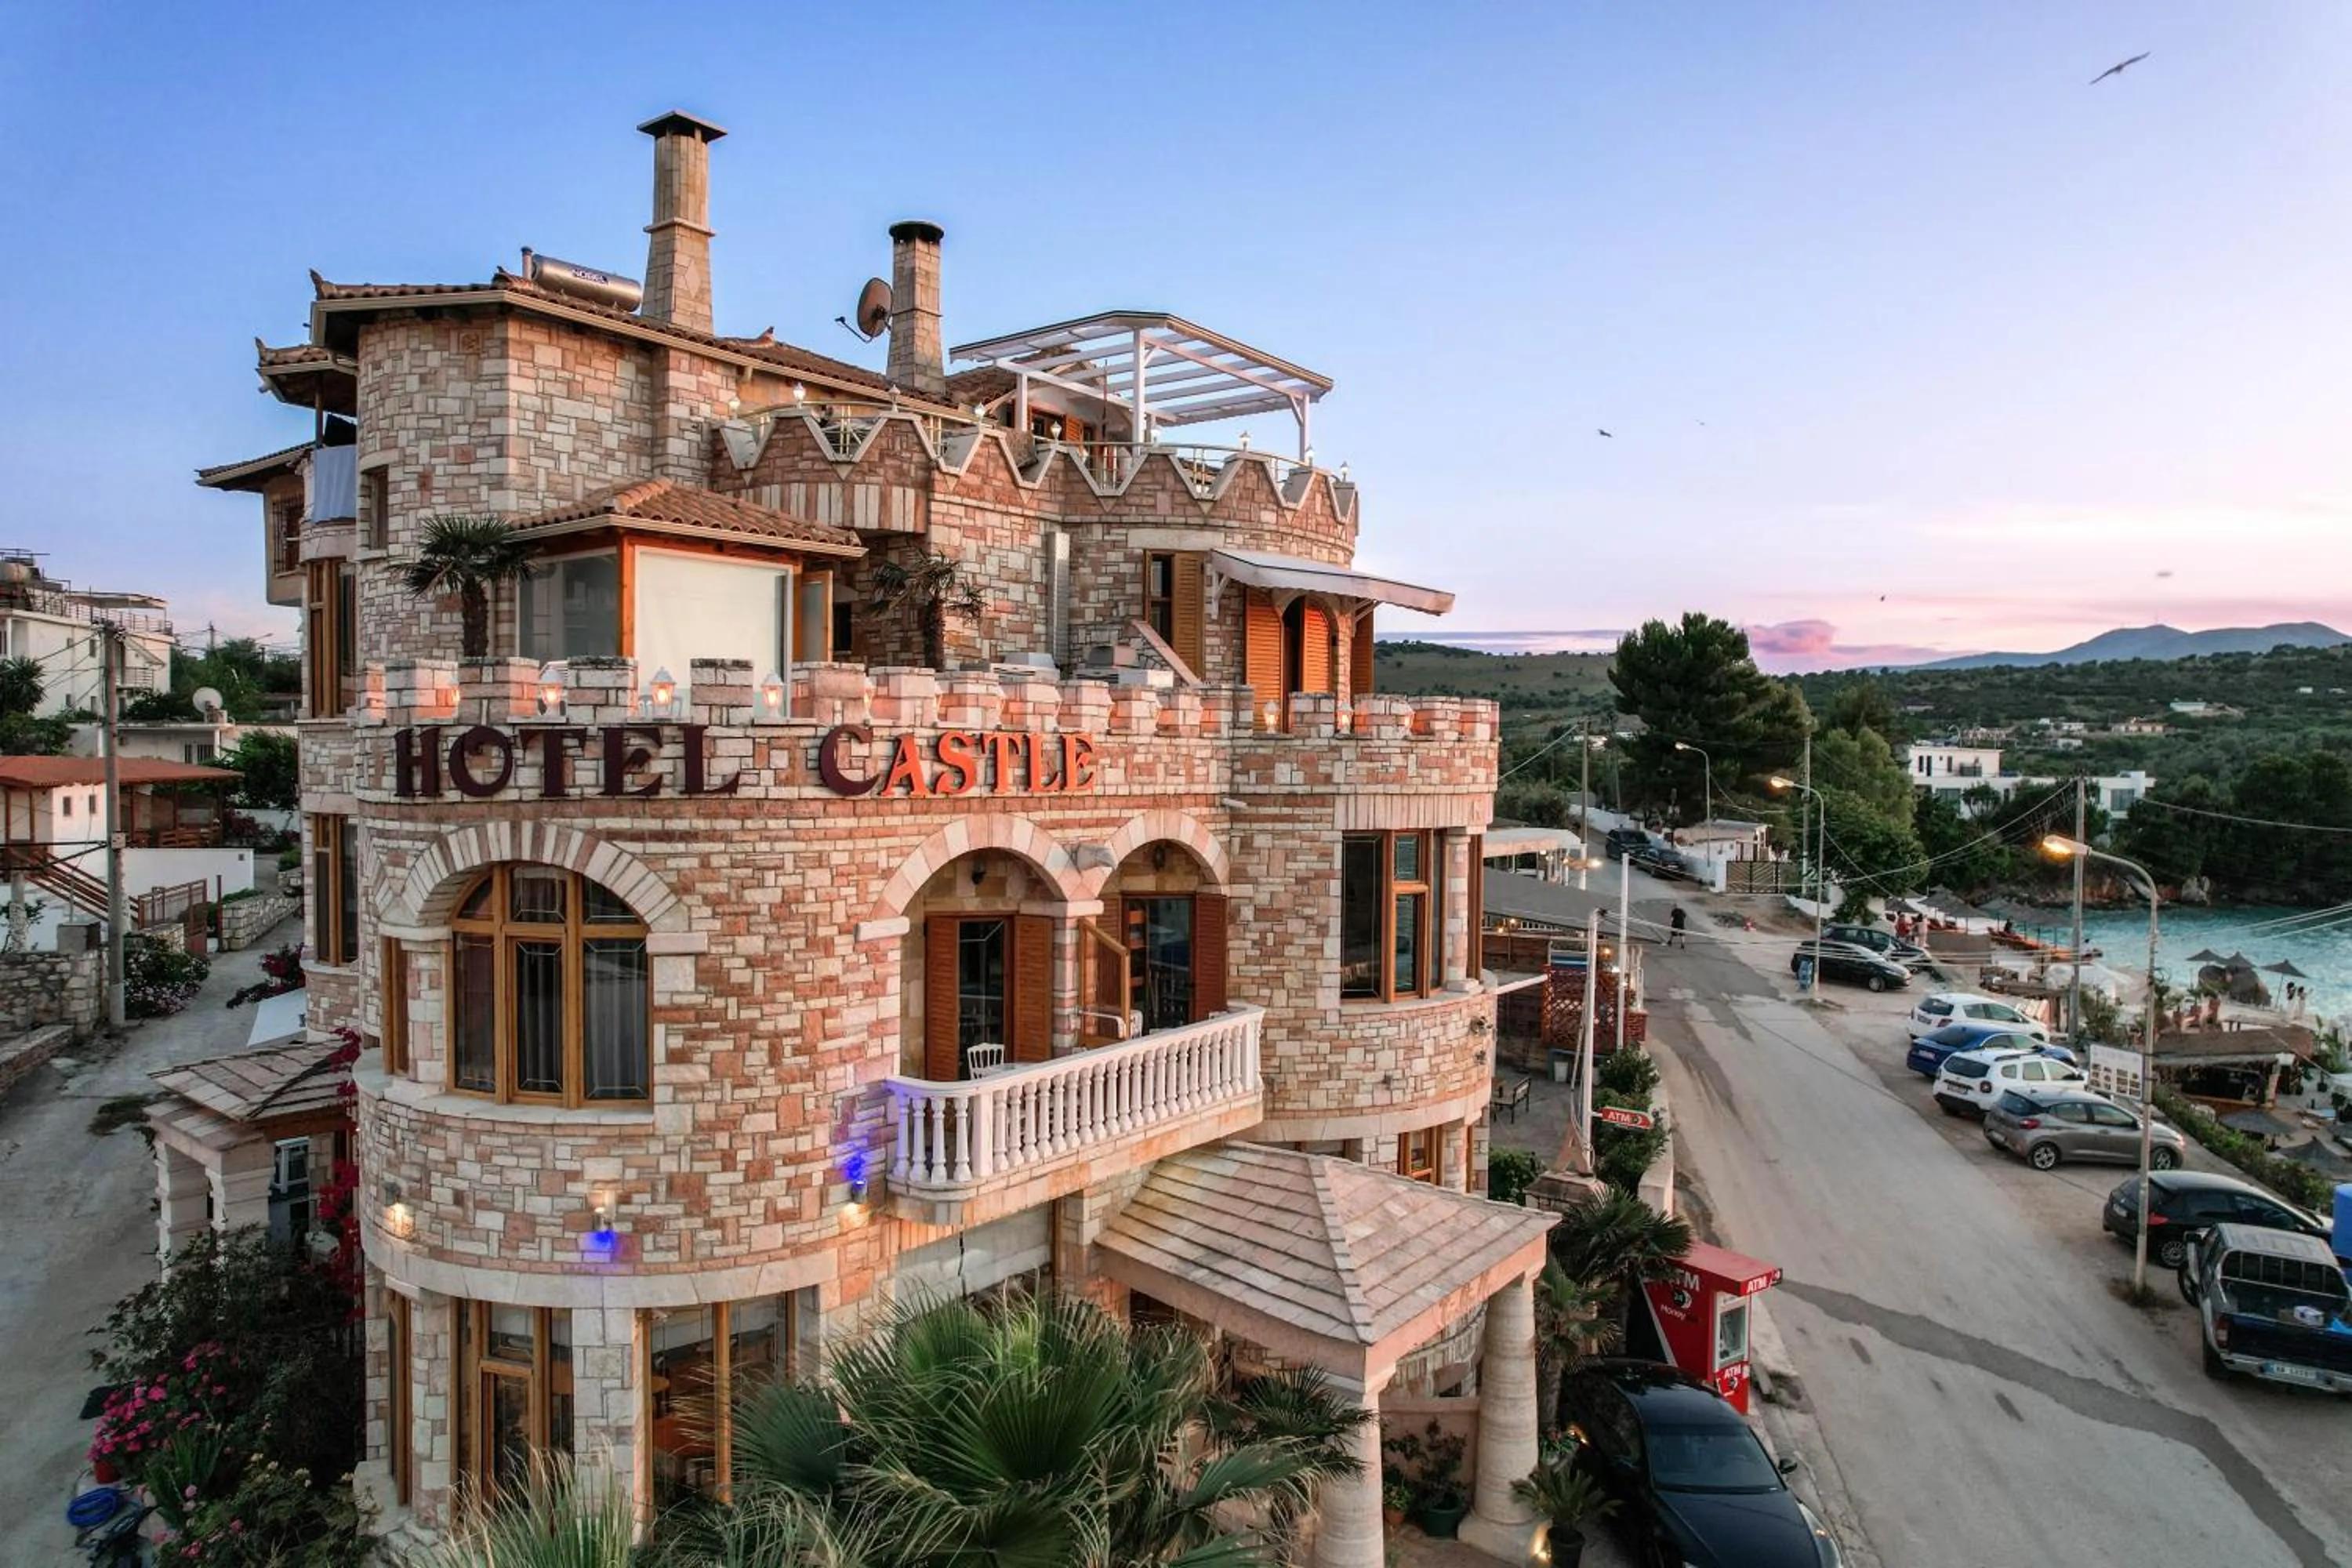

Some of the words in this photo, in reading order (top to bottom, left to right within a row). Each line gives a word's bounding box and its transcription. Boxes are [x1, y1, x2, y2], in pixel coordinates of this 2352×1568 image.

[394, 724, 741, 797] HOTEL
[818, 724, 1094, 798] CASTLE
[1608, 1111, 1631, 1123] ATM
[1747, 1276, 1767, 1293] ATM
[1724, 1364, 1741, 1379] ATM
